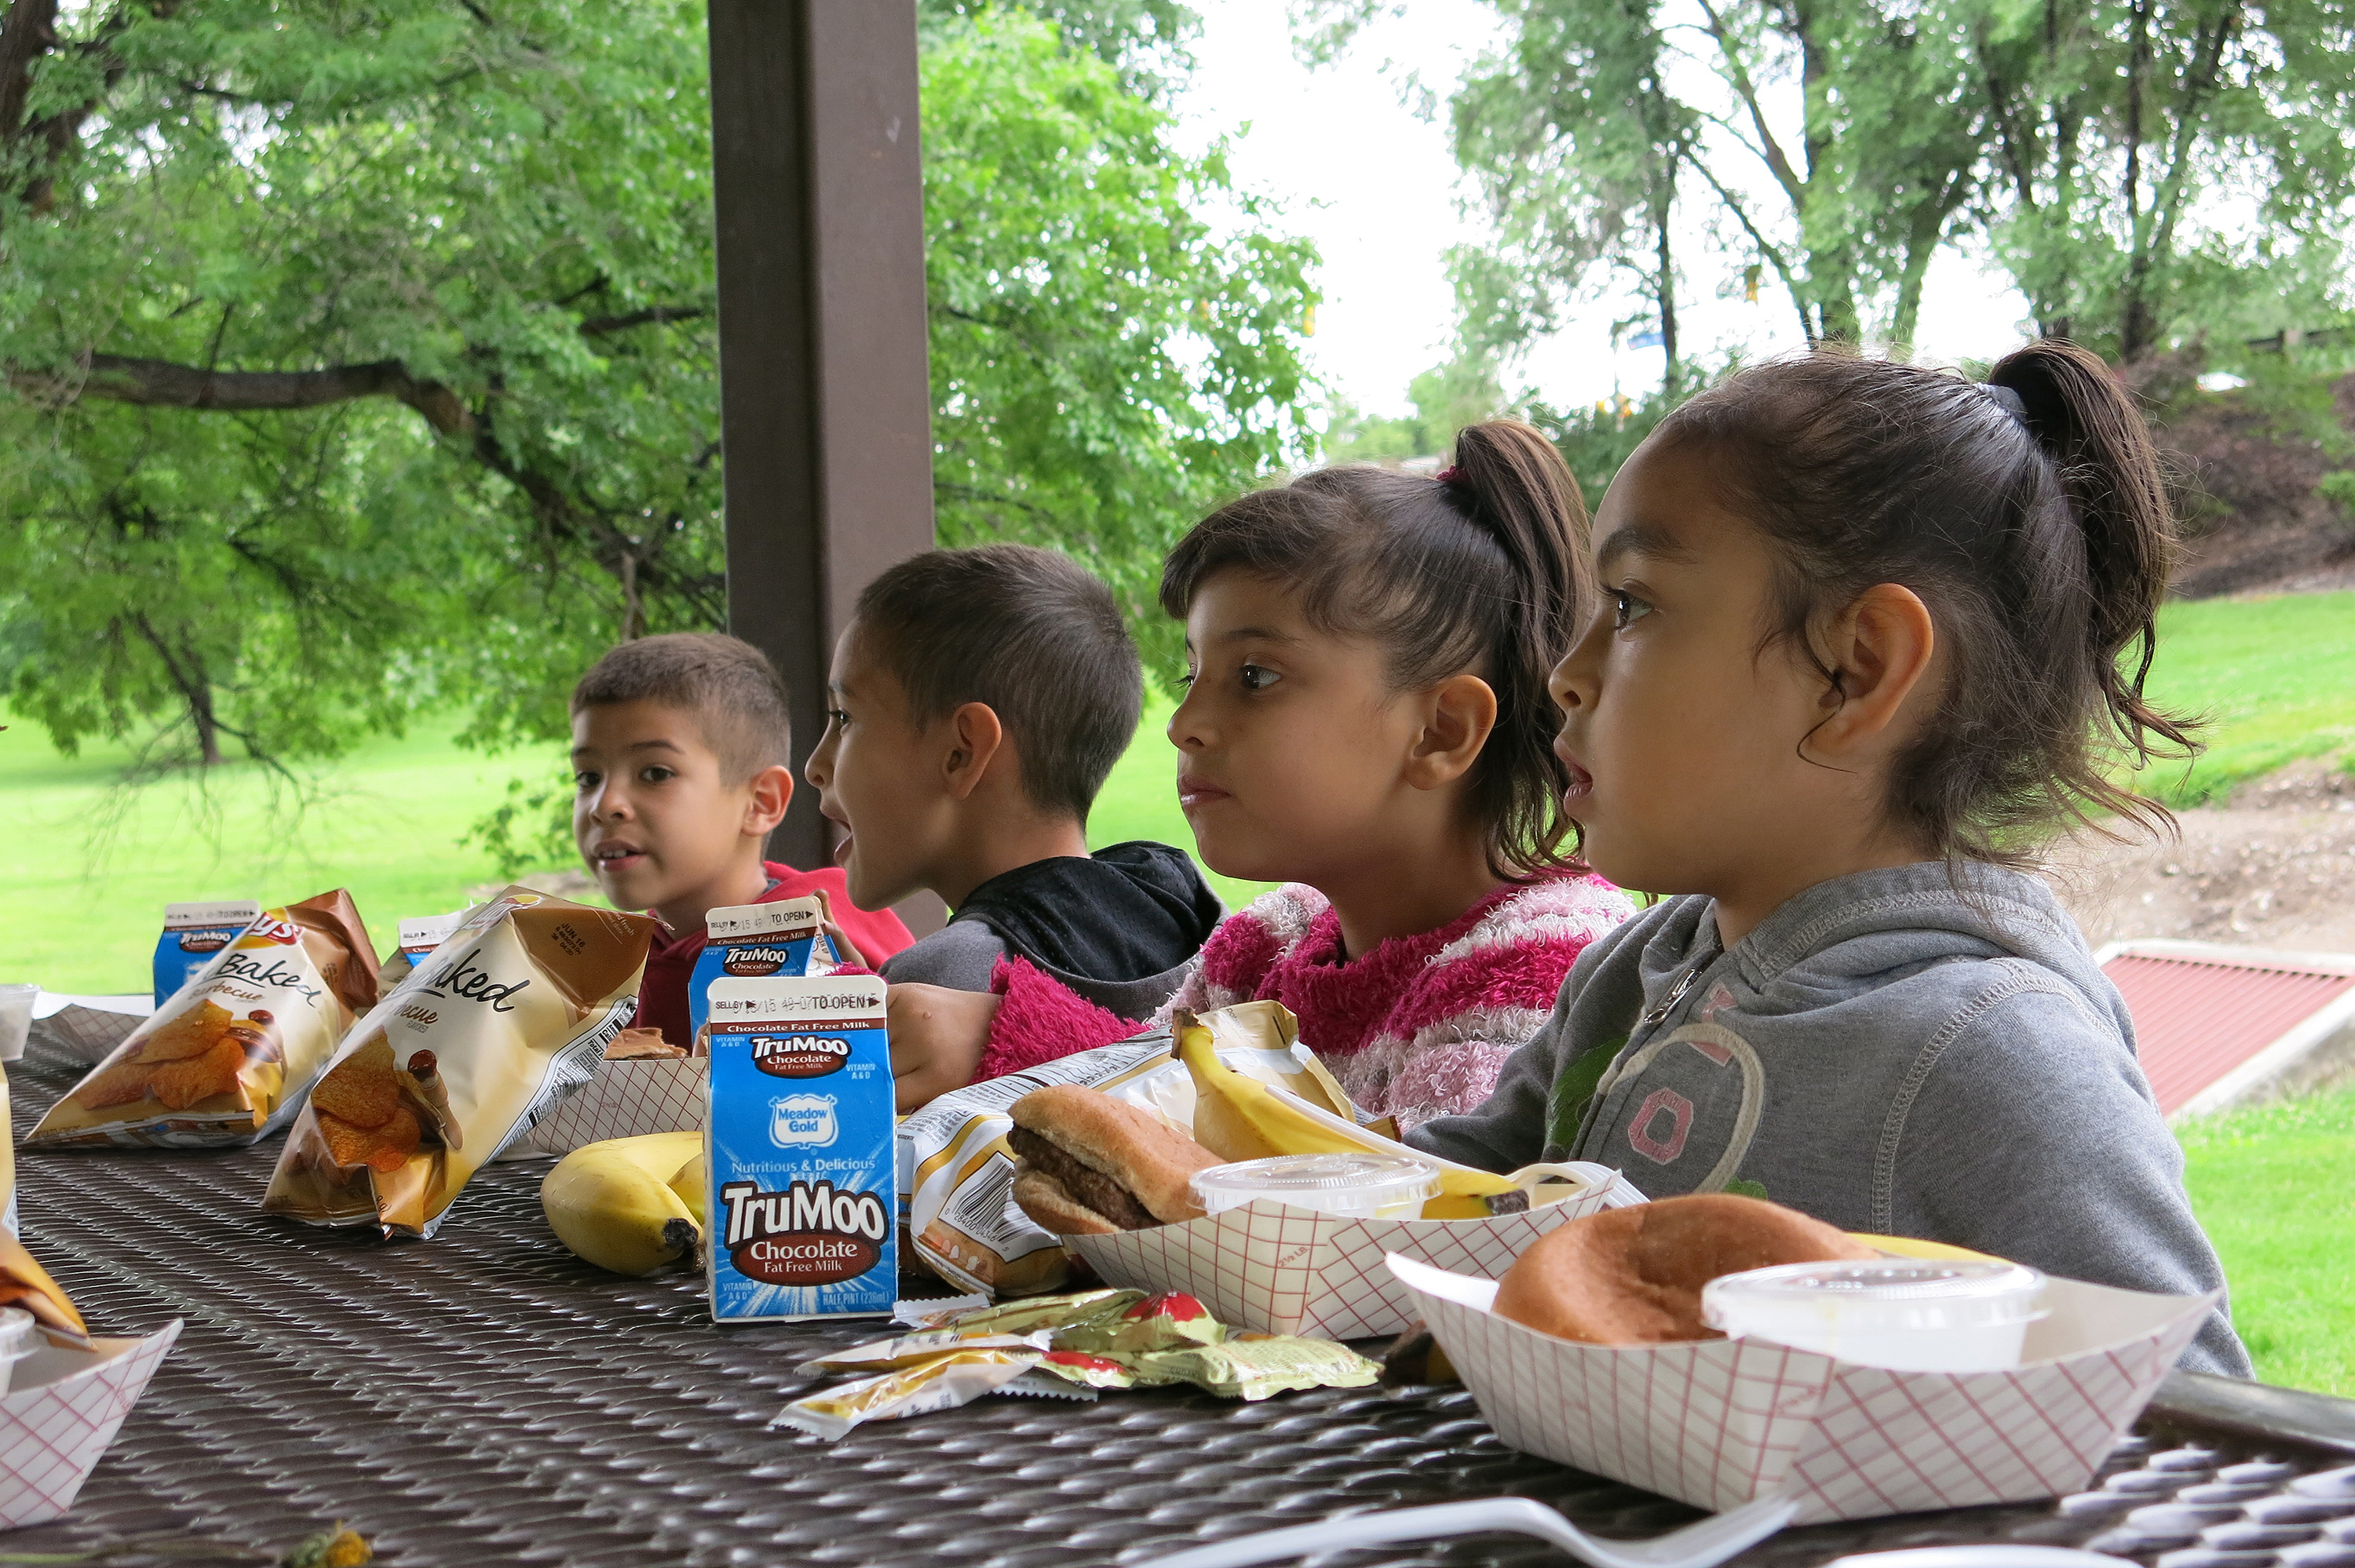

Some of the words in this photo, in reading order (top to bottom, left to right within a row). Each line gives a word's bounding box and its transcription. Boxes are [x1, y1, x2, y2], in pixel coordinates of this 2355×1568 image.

[772, 913, 782, 924] TO
[783, 910, 804, 922] OPEN
[561, 922, 577, 939] JUN
[180, 932, 232, 944] TruMoo
[725, 947, 786, 964] TruMoo
[217, 954, 322, 1008] Baked
[812, 996, 828, 1010] TO
[832, 994, 865, 1009] OPEN
[727, 1024, 787, 1033] Chocolate
[587, 1039, 601, 1054] Total
[752, 1037, 849, 1059] TruMoo
[767, 1055, 832, 1065] Chocolate
[846, 1063, 875, 1072] VITAMIN
[778, 1107, 828, 1121] Meadow
[789, 1121, 818, 1132] Gold
[732, 1161, 797, 1174] Nutritious
[801, 1161, 811, 1171] &
[815, 1158, 875, 1171] Delicious
[725, 1185, 885, 1245] TruMoo
[954, 1212, 978, 1231] 28400
[750, 1240, 858, 1260] Chocolate
[764, 1262, 783, 1273] Fat
[786, 1261, 812, 1272] Free
[815, 1260, 842, 1271] Milk
[723, 1282, 754, 1292] VITAMIN
[823, 1295, 841, 1306] HALF
[842, 1293, 860, 1305] PINT
